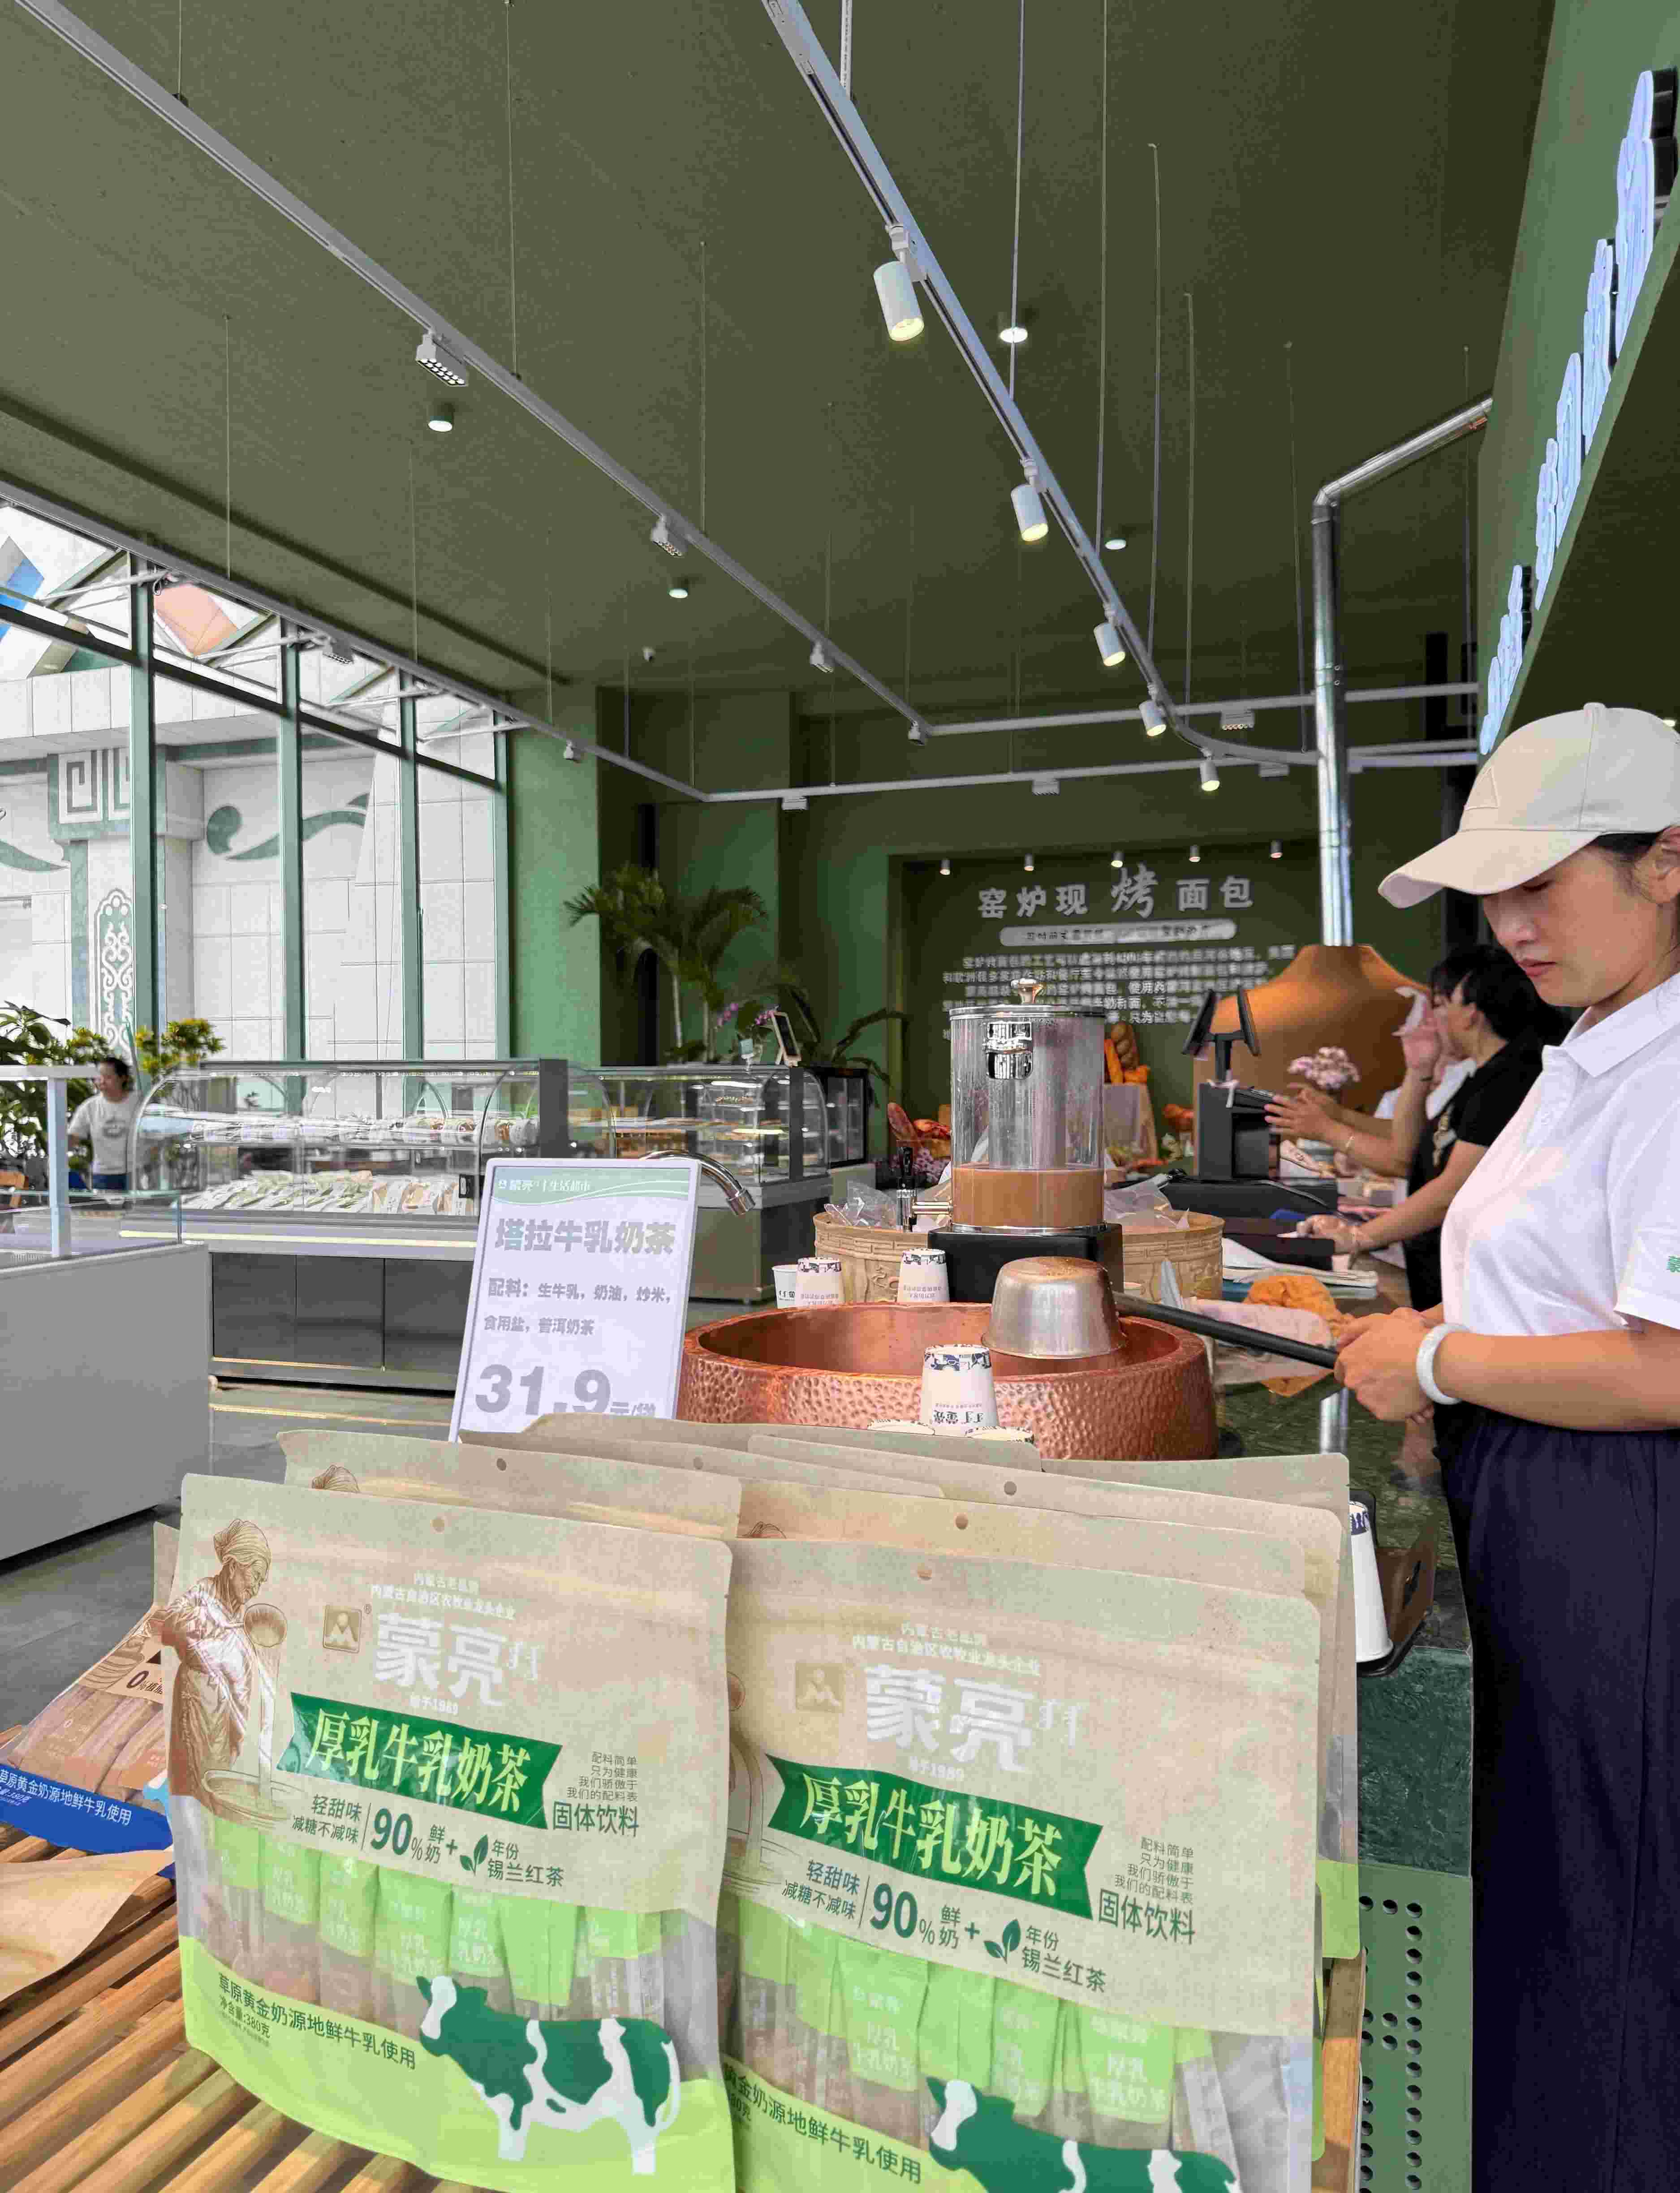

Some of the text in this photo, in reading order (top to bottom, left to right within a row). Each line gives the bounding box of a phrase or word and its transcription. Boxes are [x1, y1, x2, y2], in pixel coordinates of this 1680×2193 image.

[978, 863, 1253, 918] 窑炉现烤面包
[494, 1218, 676, 1254] 塔拉牛乳奶茶
[373, 1613, 508, 1706] 蒙亮
[864, 1663, 1038, 1773] 蒙亮
[305, 1708, 531, 1813] 厚乳牛乳奶茶
[591, 1751, 638, 1766] 配料简单
[591, 1764, 638, 1778] 只为健康
[311, 1794, 362, 1822] 轻甜味
[567, 1787, 638, 1802] 我们的配料表
[292, 1815, 359, 1844] 减糖不减味
[553, 1801, 639, 1837] 固体饮料
[800, 1772, 1062, 1896] 厚乳牛乳奶茶
[491, 1839, 519, 1861] 年份
[1140, 1853, 1193, 1874] 只为健康
[1142, 1836, 1193, 1858] 配料简单
[487, 1858, 564, 1888] 锡兰红茶
[806, 1859, 860, 1896] 轻甜味
[1115, 1874, 1193, 1903] 我们的配料表
[781, 1879, 857, 1920] 减糖不减味
[1099, 1888, 1195, 1945] 固体饮料
[1025, 1925, 1059, 1951] 年份
[1021, 1946, 1107, 1993] 锡兰红茶
[219, 1972, 416, 2069] 草原黄金奶源地鲜牛乳使用
